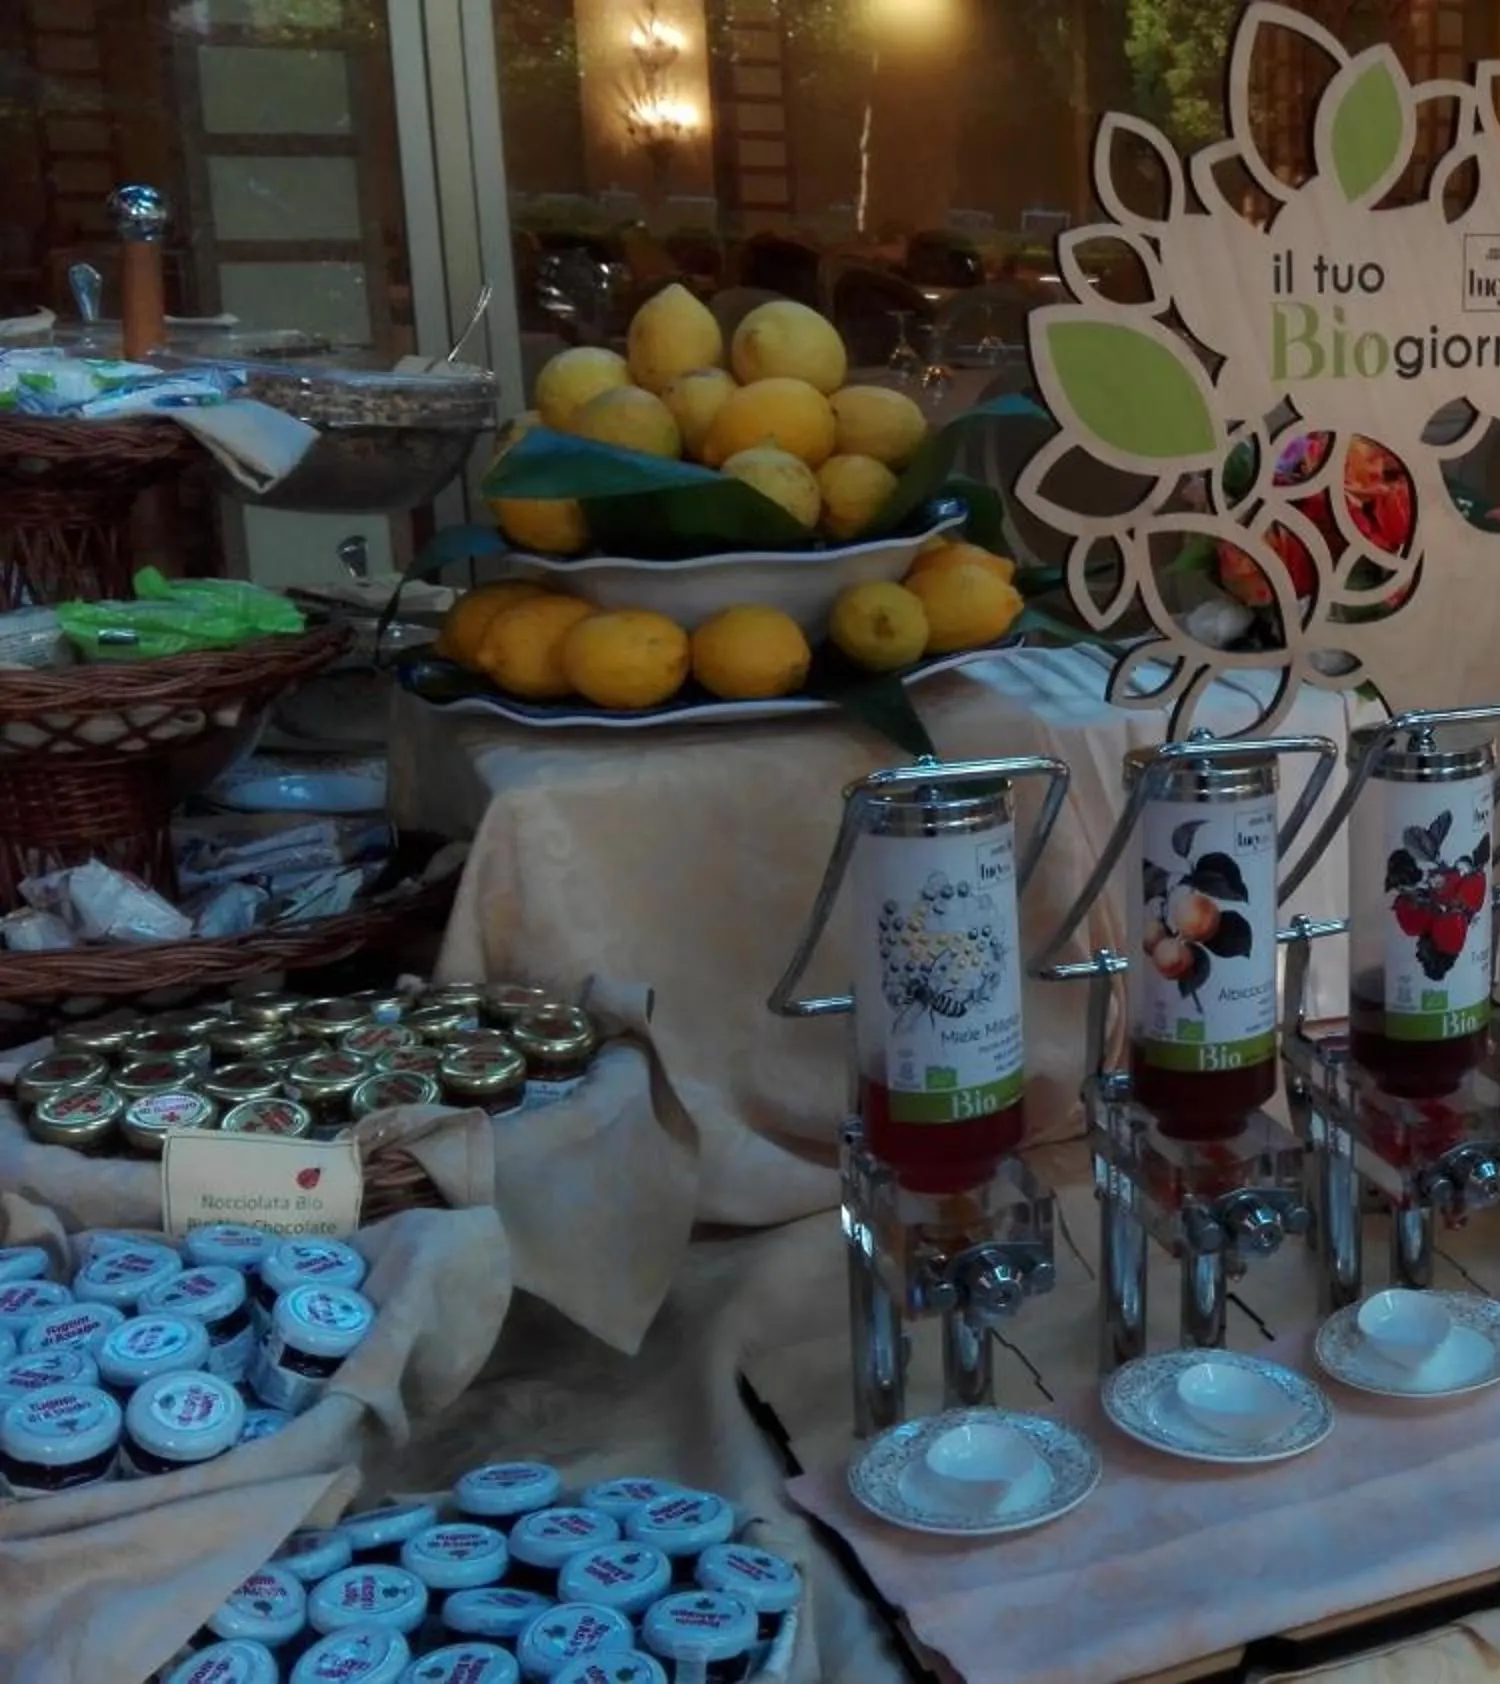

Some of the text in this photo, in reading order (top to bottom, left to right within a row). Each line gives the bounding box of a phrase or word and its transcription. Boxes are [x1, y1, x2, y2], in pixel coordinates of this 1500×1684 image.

[1273, 249, 1385, 294] il tuo
[1442, 1011, 1477, 1038] Bio
[1200, 1045, 1242, 1072] Bio
[951, 1089, 997, 1120] Bio
[201, 1194, 323, 1211] Nocciolata Bio
